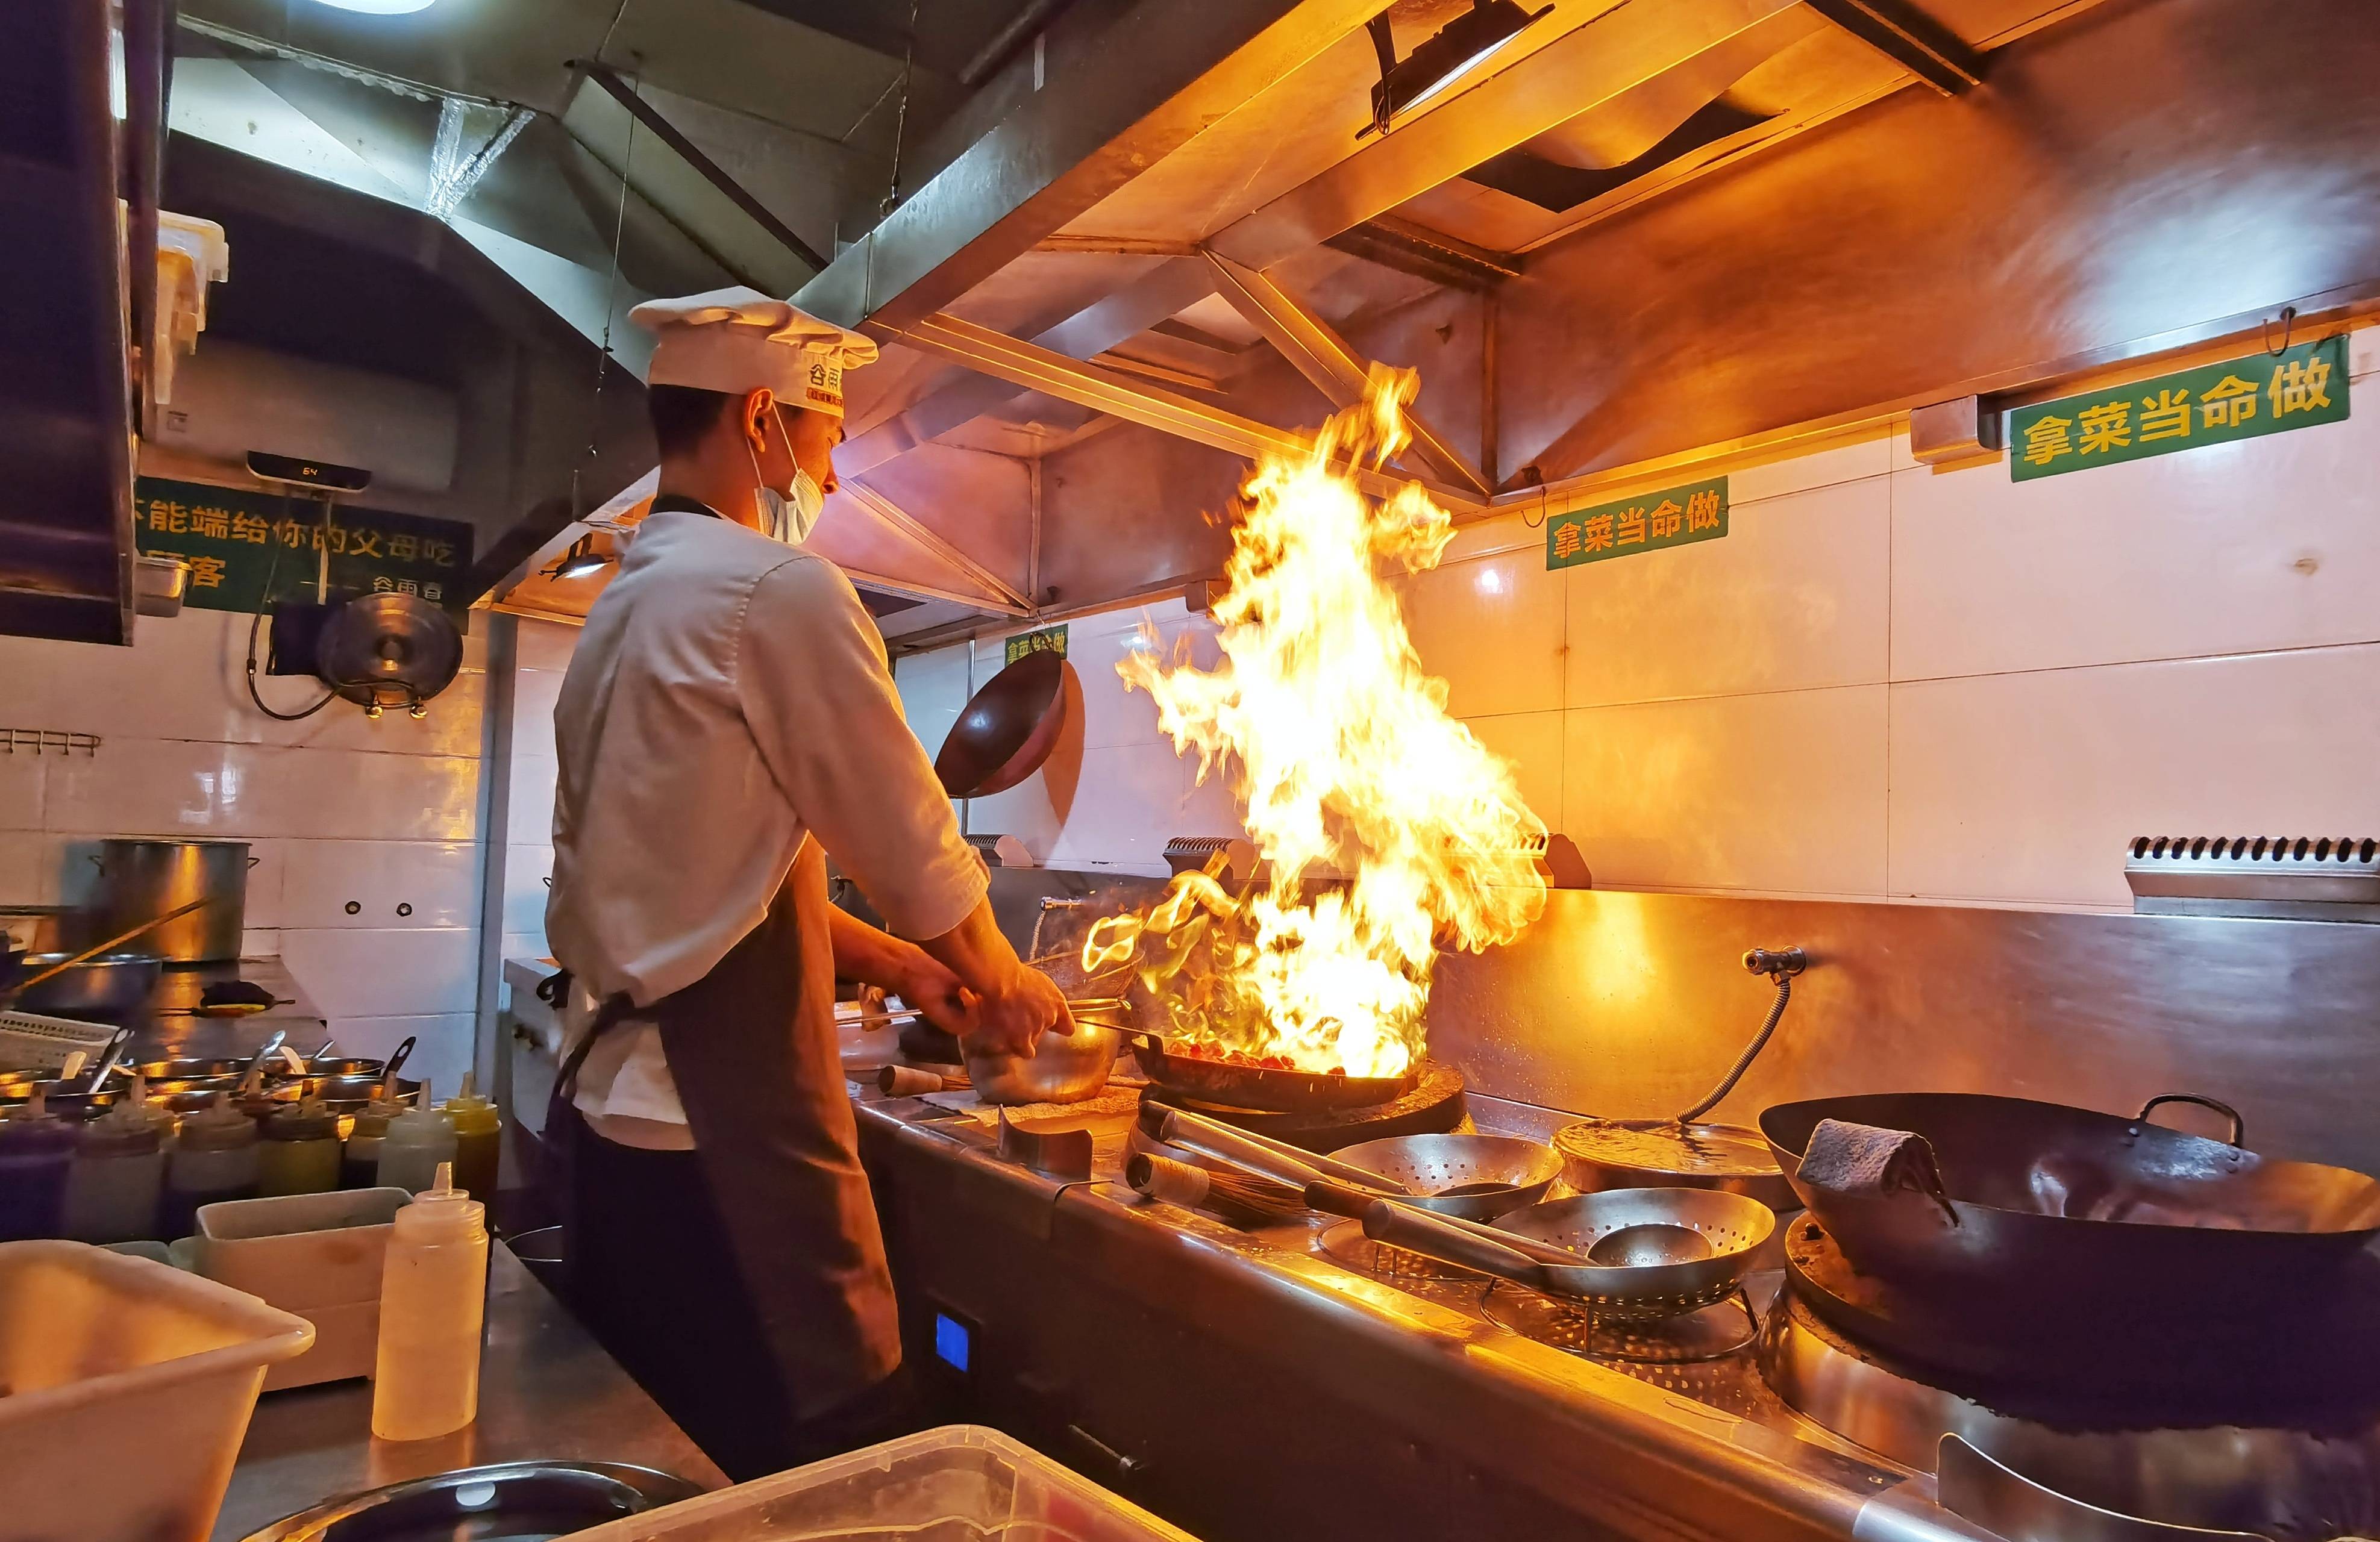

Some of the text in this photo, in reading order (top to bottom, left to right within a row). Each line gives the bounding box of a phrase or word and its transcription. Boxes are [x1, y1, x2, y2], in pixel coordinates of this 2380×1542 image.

[810, 364, 841, 391] 谷雨
[2023, 357, 2332, 466] 拿菜当命做
[1553, 489, 1720, 559] 拿菜当命做
